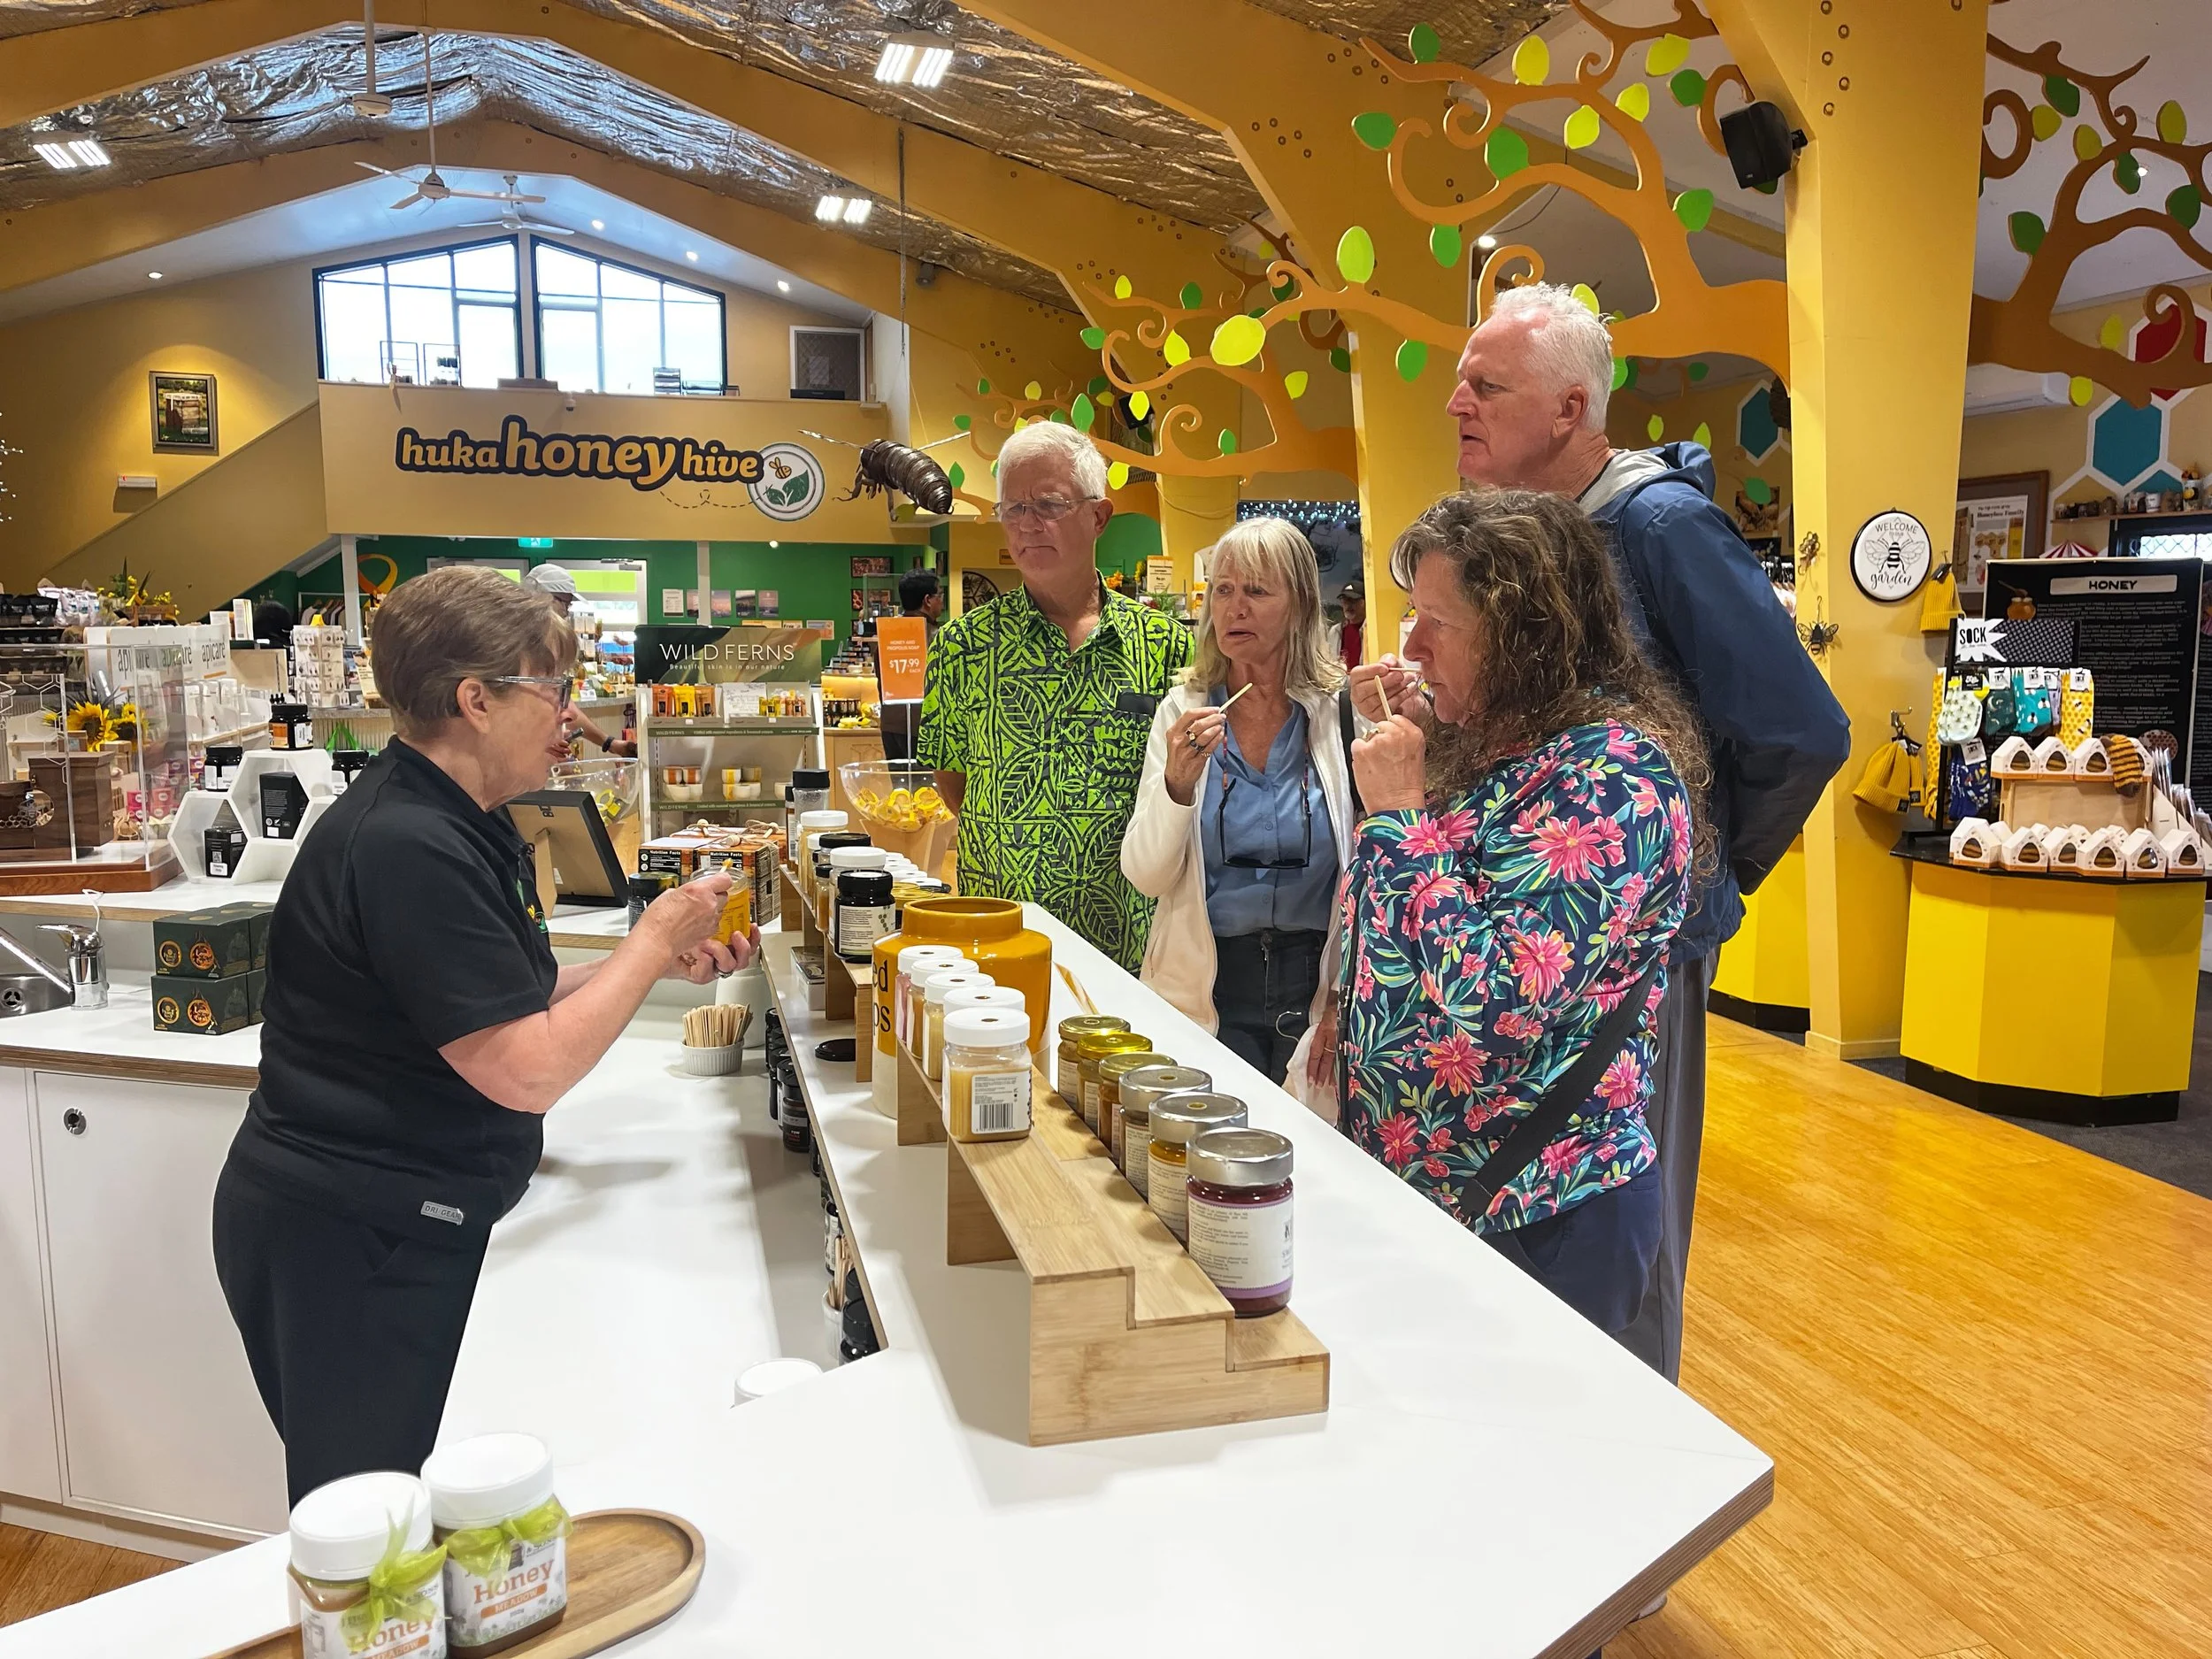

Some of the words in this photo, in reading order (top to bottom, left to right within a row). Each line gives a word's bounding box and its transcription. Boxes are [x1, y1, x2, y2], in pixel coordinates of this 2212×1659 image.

[401, 432, 500, 469] huka
[504, 419, 678, 486] honey
[681, 443, 760, 480] hive
[1875, 522, 1918, 534] WELCOME
[1870, 570, 1912, 590] garden
[2089, 580, 2138, 590] HONEY
[1959, 626, 1986, 645] SOCK
[201, 636, 226, 670] apicare
[659, 643, 719, 662] WILD
[725, 644, 795, 662] FERNS
[889, 658, 920, 674] $17.99
[425, 1205, 439, 1214] DRI
[473, 1559, 554, 1604] Honey
[494, 1587, 538, 1614] MEADOW
